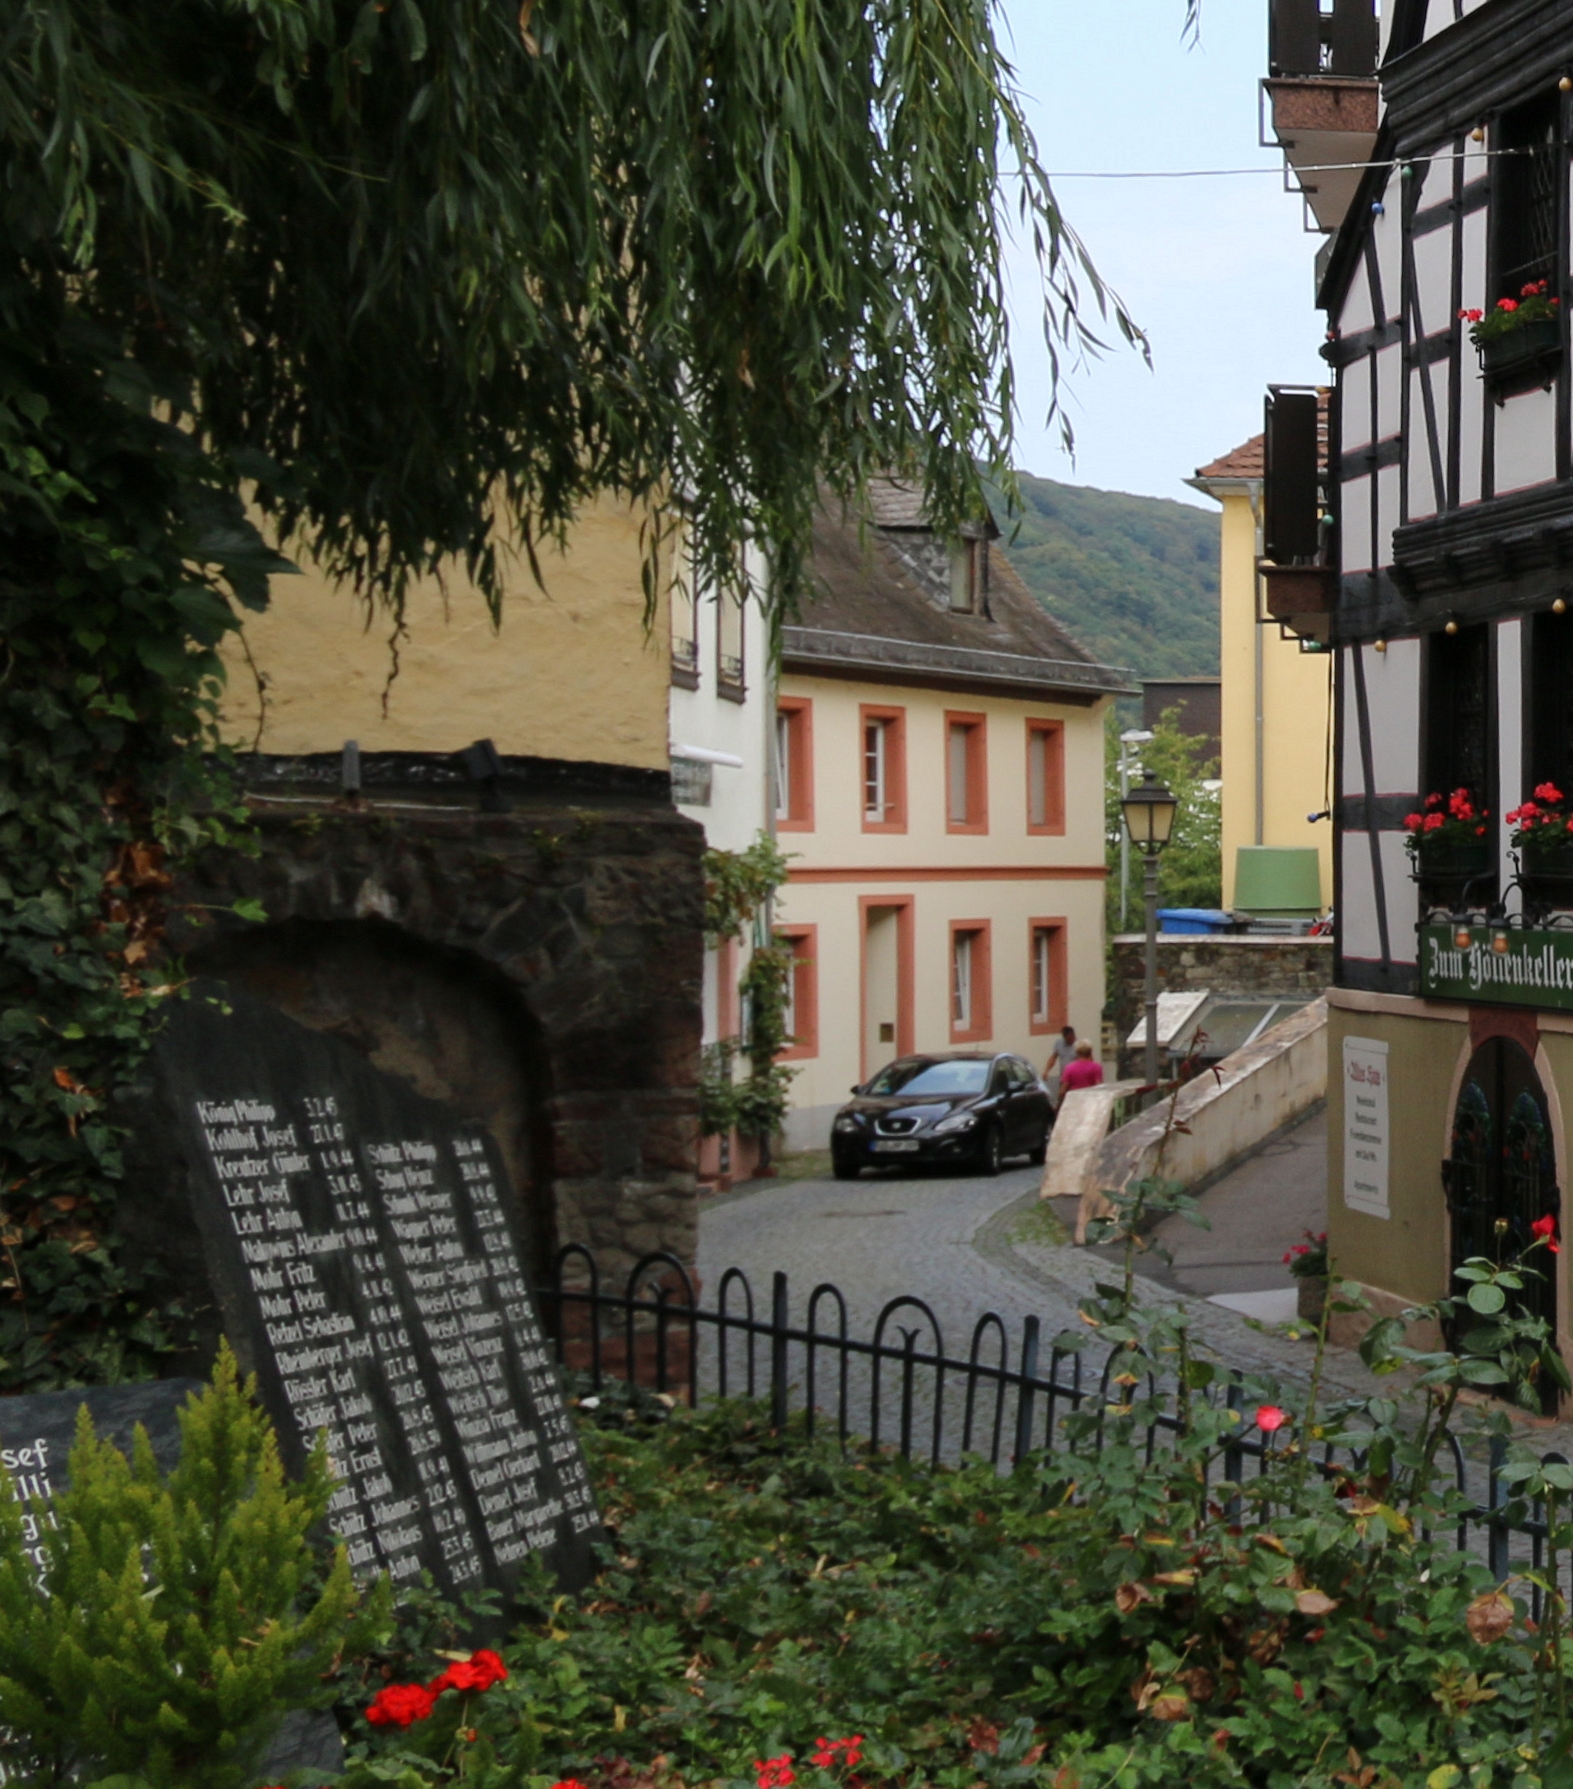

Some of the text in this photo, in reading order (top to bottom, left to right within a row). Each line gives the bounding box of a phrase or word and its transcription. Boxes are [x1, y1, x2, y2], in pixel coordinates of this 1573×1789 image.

[1429, 937, 1463, 989] Zum
[223, 1183, 254, 1207] Lehr
[258, 1178, 290, 1203] Josef
[231, 1210, 263, 1235] Lehr
[344, 1331, 374, 1359] Josef
[329, 1367, 356, 1393] Karl
